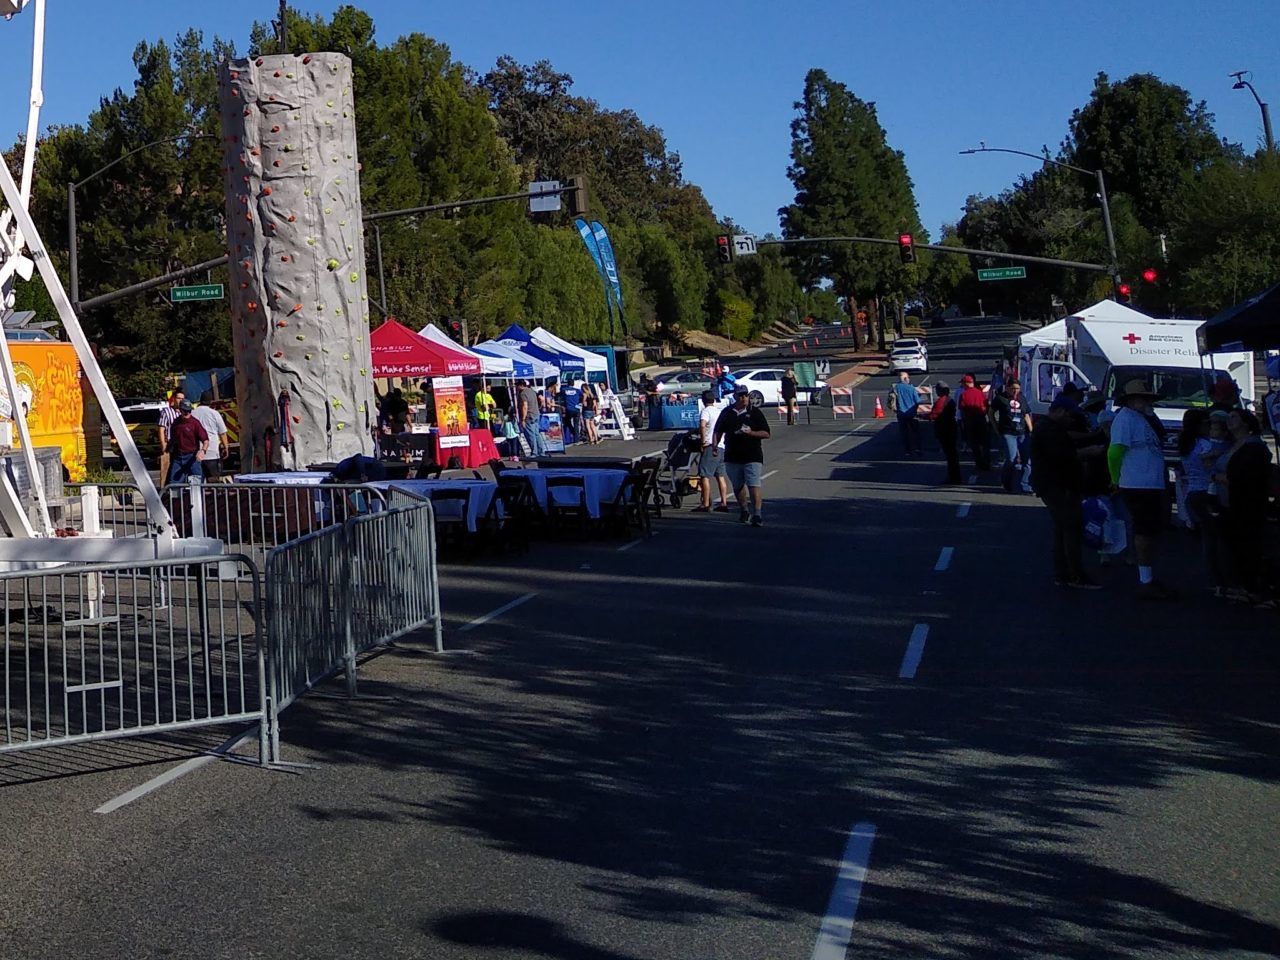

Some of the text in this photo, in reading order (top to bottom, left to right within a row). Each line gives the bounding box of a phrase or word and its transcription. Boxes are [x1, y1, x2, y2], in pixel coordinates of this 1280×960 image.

[201, 288, 219, 296] Road
[1130, 347, 1170, 355] Disaster
[382, 365, 403, 373] Make
[404, 364, 432, 373] Sense!
